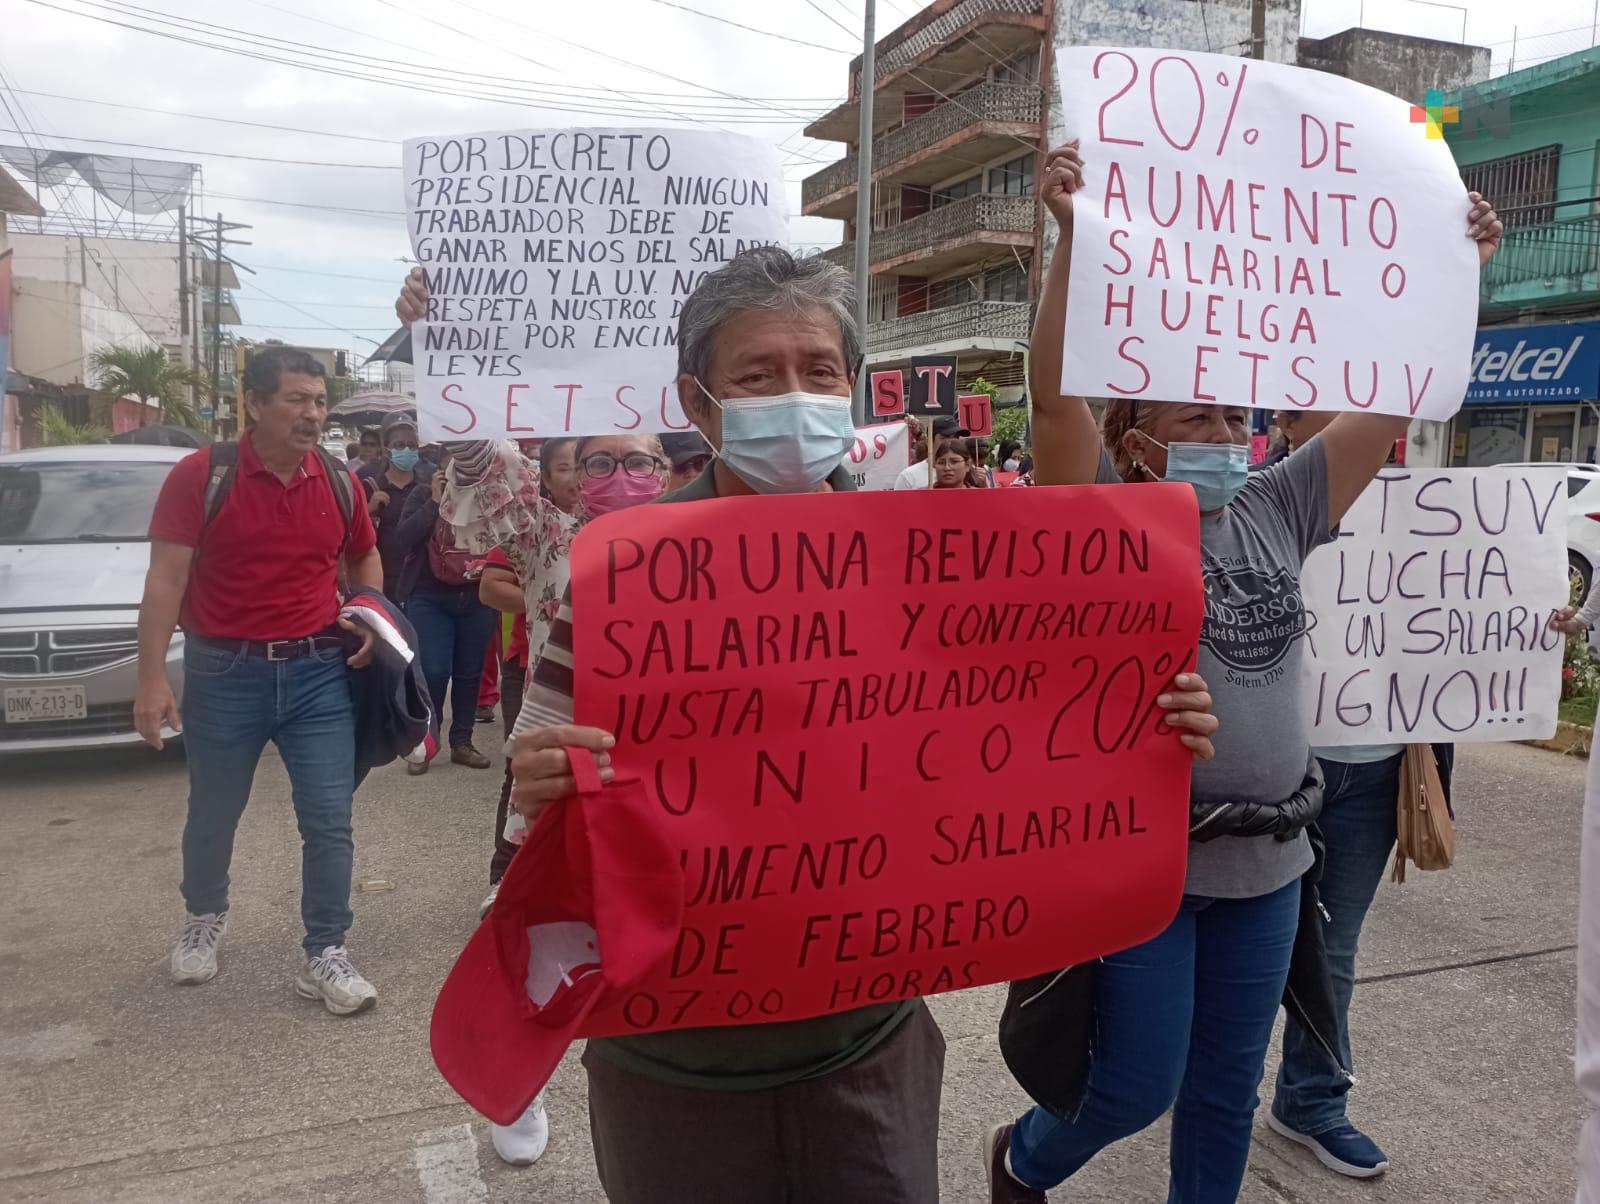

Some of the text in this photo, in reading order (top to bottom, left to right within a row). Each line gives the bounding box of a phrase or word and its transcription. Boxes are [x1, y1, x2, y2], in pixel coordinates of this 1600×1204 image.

[1093, 51, 1357, 173] 20% DE
[416, 132, 671, 176] POR DECRETO
[411, 174, 768, 207] PRESIDENCIAL NINGUN
[1104, 162, 1398, 250] AUMENTO
[415, 208, 734, 235] TRABAJADOR DEBE DE
[417, 237, 507, 263] GANAR
[524, 239, 625, 263] MENOS
[636, 239, 676, 263] DEL
[1103, 229, 1406, 298] SALARIAL O
[423, 267, 528, 295] MINIMO
[547, 269, 561, 295] Y
[571, 269, 602, 295] LA
[615, 270, 658, 295] U.V.
[426, 298, 537, 322] RESPETA
[551, 298, 656, 321] NUSTROS
[1104, 283, 1317, 344] HUELGA
[425, 326, 509, 351] NADIE
[525, 324, 575, 349] POR
[427, 354, 522, 376] LEYES
[915, 365, 952, 408] T
[1106, 336, 1433, 416] SETSUV
[878, 378, 898, 408] S
[963, 402, 985, 432] U
[1506, 386, 1580, 398] AUTORIZADO
[606, 527, 1149, 604] POR UNA REVISION
[1337, 547, 1512, 605] LUCHA
[592, 601, 1181, 679] SALARIAL Y CONTRACTUAL
[1208, 623, 1227, 641] bed
[1346, 612, 1385, 659] UN
[1402, 606, 1560, 655] SALARIO
[613, 647, 1194, 761] JUSTA TABULADOR 20%
[655, 724, 1012, 816] UNICO
[929, 796, 1147, 866] SALARIAL
[669, 895, 1029, 979] DE FEBRERO
[622, 961, 981, 1029] 07:00 HORAS
